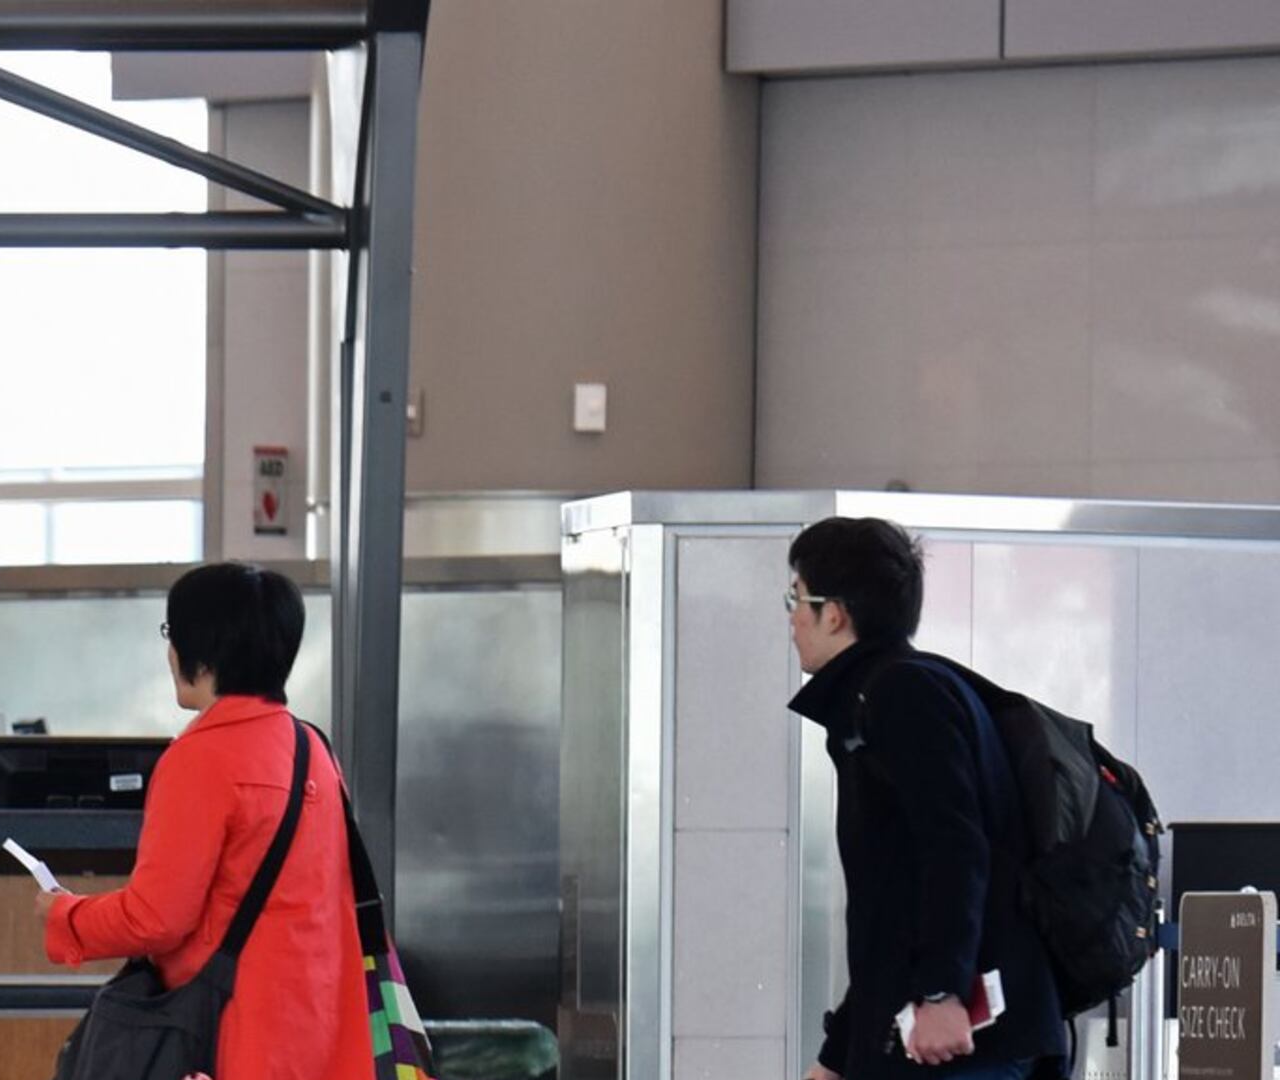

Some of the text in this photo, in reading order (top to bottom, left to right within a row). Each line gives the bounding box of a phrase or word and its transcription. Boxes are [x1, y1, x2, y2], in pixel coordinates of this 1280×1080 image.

[1181, 955, 1240, 989] CARRY-ON
[1180, 1005, 1246, 1040] SIZE CHECK
